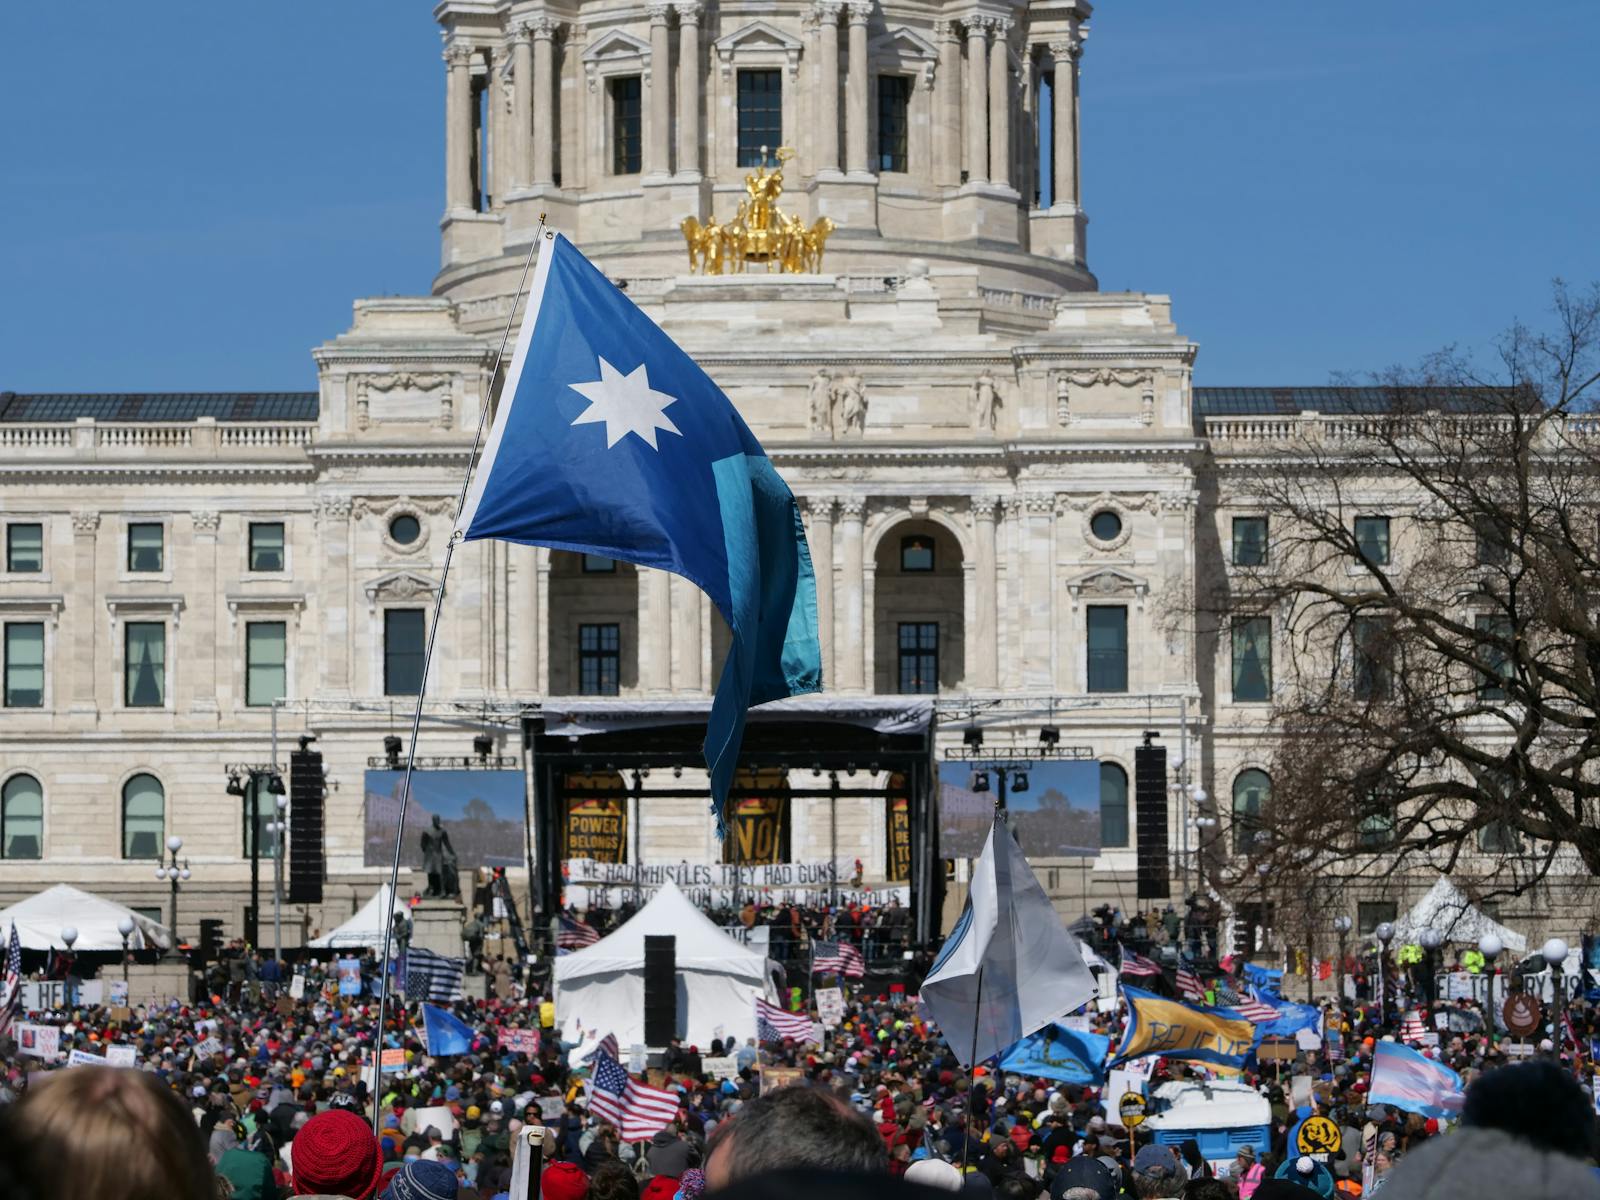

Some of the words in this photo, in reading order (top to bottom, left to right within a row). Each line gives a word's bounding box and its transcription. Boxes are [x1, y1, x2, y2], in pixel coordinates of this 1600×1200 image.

[570, 816, 618, 833] POWER
[570, 835, 618, 849] BELONGS
[732, 817, 772, 860] NO
[582, 861, 598, 879] WE
[606, 863, 635, 882] HAD
[721, 865, 757, 885] THEY
[764, 865, 792, 885] HAD
[587, 887, 612, 908] THE
[720, 887, 774, 909] SARTS
[1148, 1021, 1249, 1056] BELIEVE
